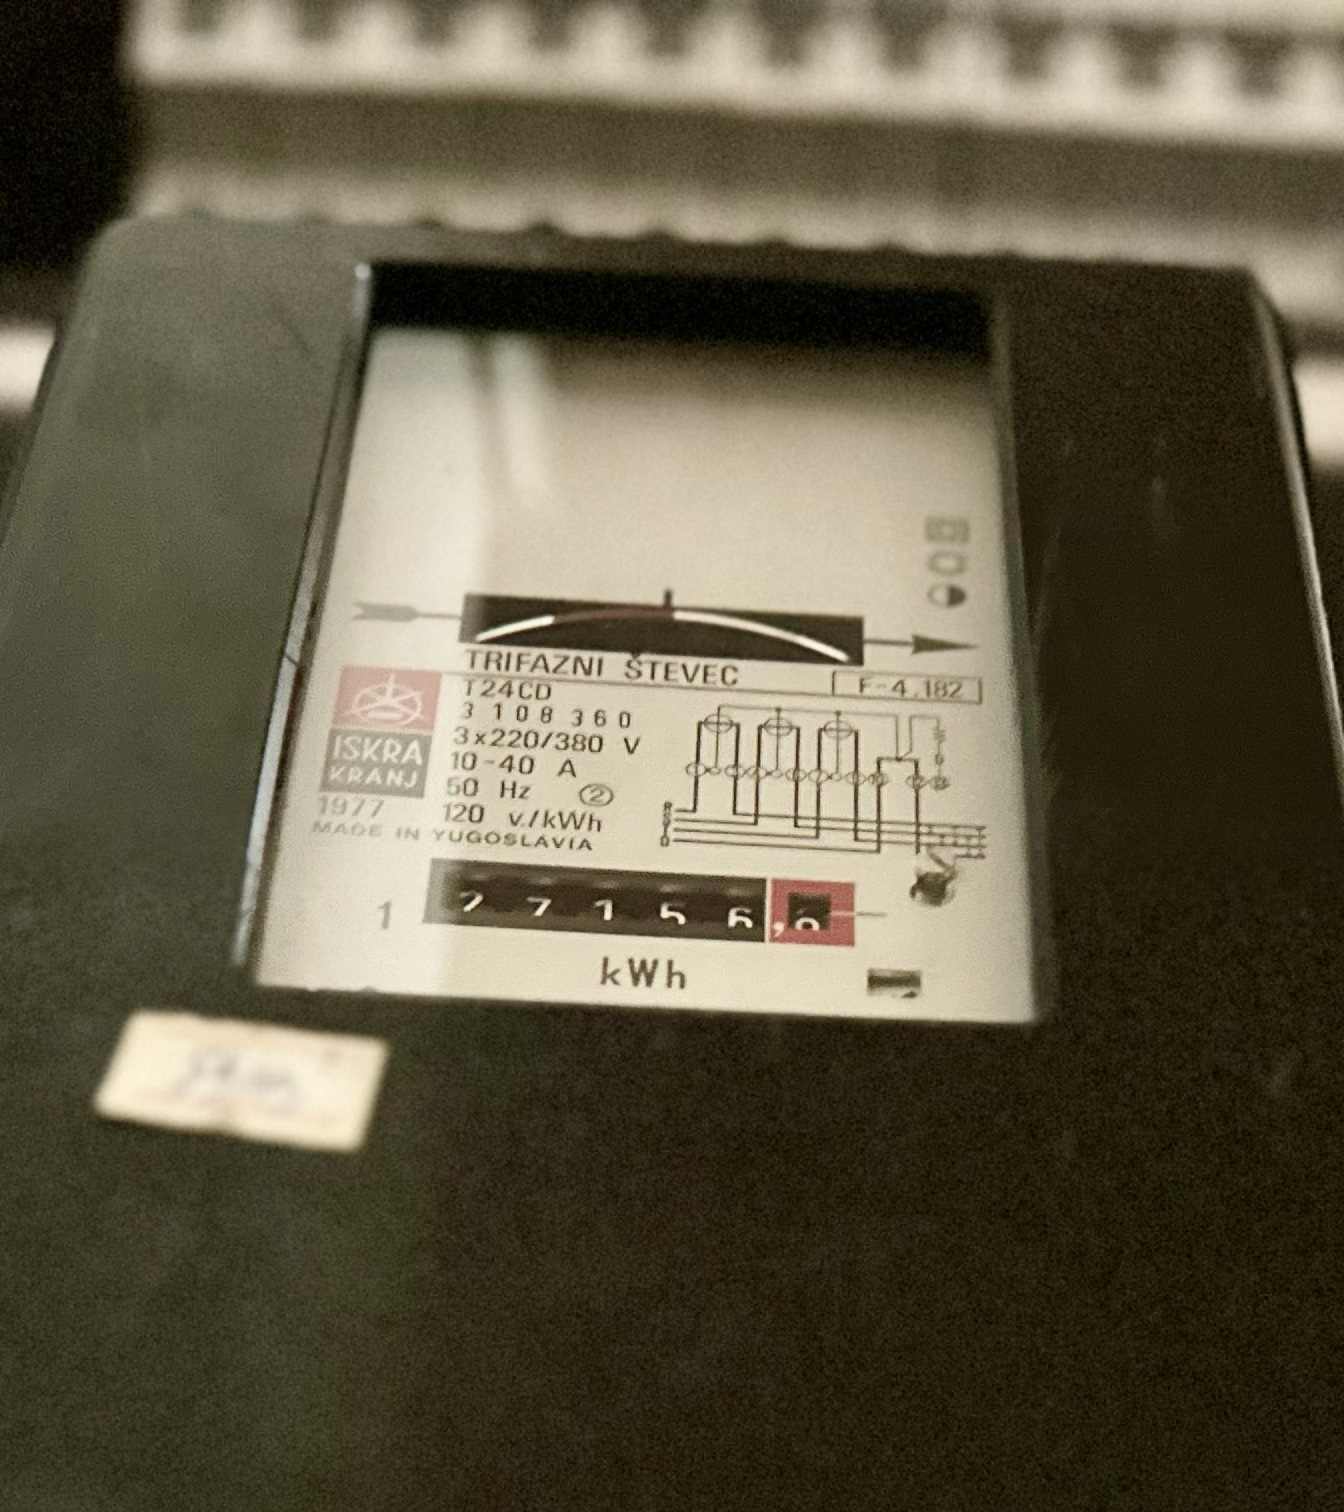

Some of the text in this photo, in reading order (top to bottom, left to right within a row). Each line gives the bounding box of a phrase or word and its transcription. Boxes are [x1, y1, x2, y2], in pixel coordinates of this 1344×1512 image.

[465, 650, 603, 677] TRIFAZNI
[464, 679, 551, 701] T24CD
[332, 733, 423, 766] ISKRA
[453, 727, 641, 755] 3x220/380 V
[329, 765, 418, 789] KRANJ
[451, 751, 577, 778] 10-40 A
[446, 777, 531, 800] 50 Hz
[319, 795, 386, 818] 1977
[442, 802, 485, 824] 120
[311, 819, 593, 851] MADE IN YUGOSLAVIA
[377, 900, 392, 929] 1
[600, 956, 687, 990] kWh
